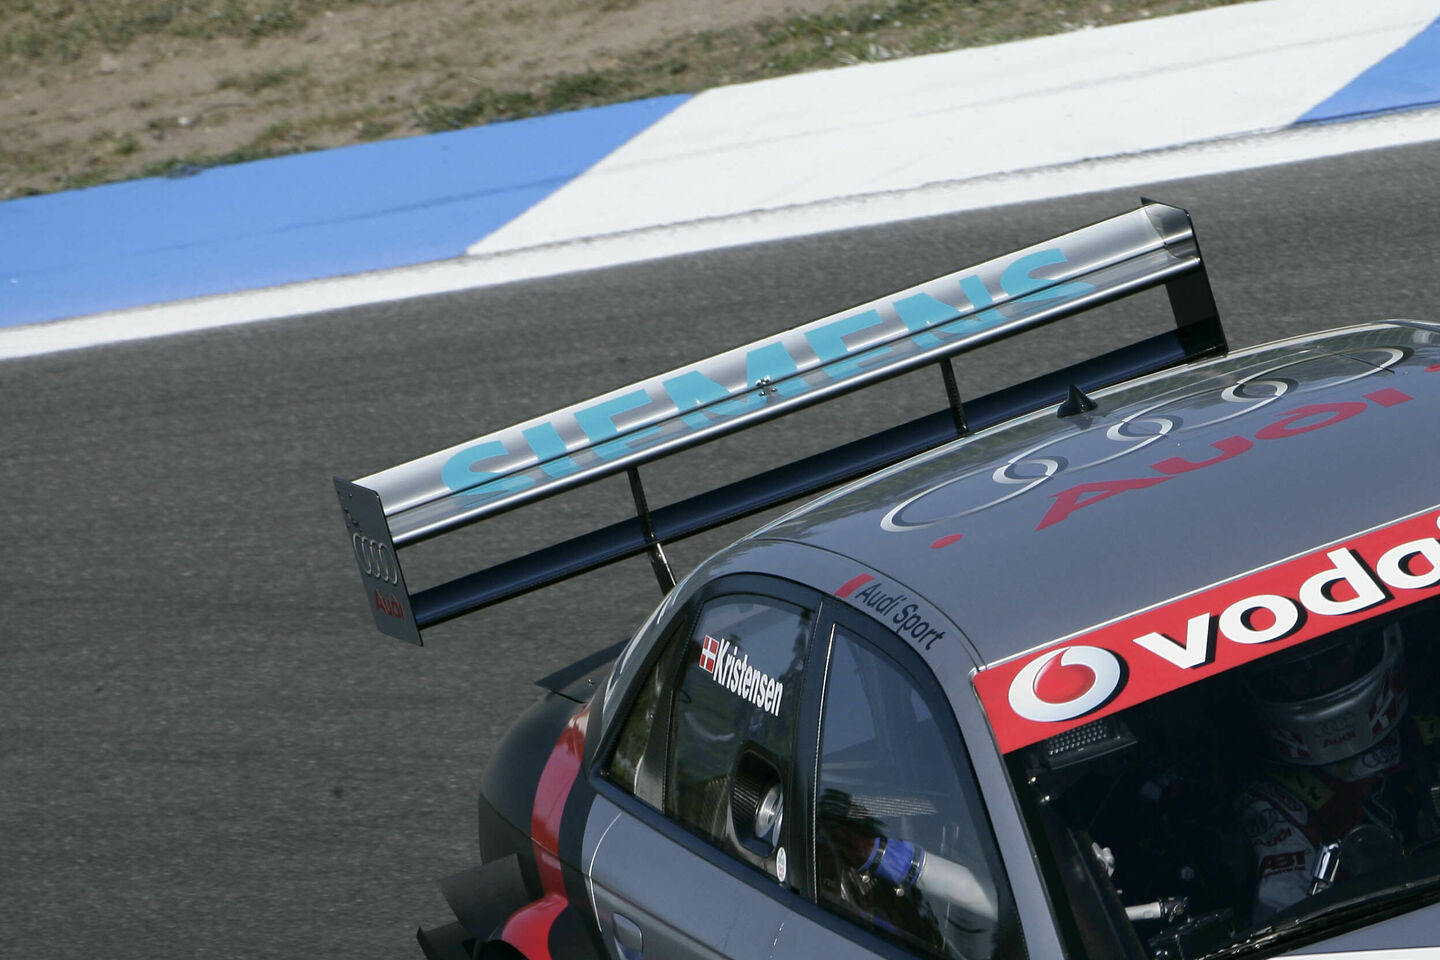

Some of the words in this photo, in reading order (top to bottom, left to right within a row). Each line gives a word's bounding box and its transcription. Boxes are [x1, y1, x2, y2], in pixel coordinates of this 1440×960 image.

[440, 247, 1096, 510] SIEMENS
[374, 589, 406, 621] Audi
[856, 583, 905, 619] Audi
[894, 604, 946, 651] Sport
[713, 638, 784, 716] Kristensen
